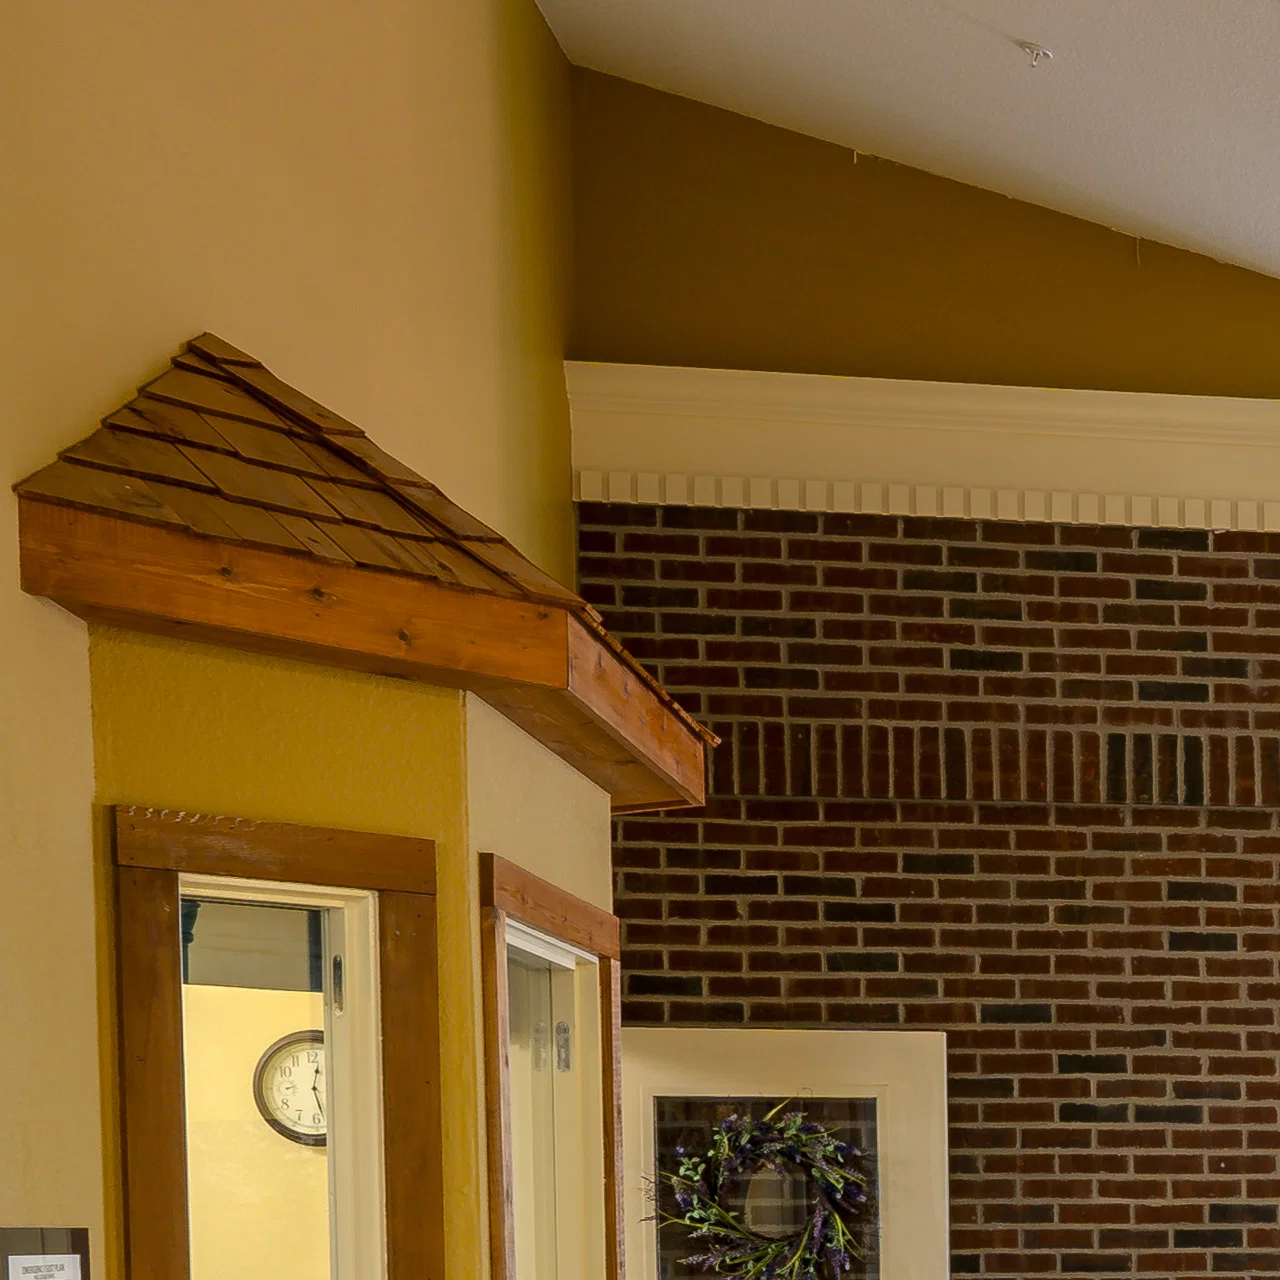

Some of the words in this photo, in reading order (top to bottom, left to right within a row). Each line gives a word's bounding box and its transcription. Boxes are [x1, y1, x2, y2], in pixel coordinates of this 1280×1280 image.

[291, 1055, 300, 1067] 11
[306, 1051, 318, 1064] 12
[279, 1065, 292, 1078] 10
[281, 1098, 290, 1110] 8
[295, 1109, 303, 1121] 7
[312, 1112, 321, 1124] 6
